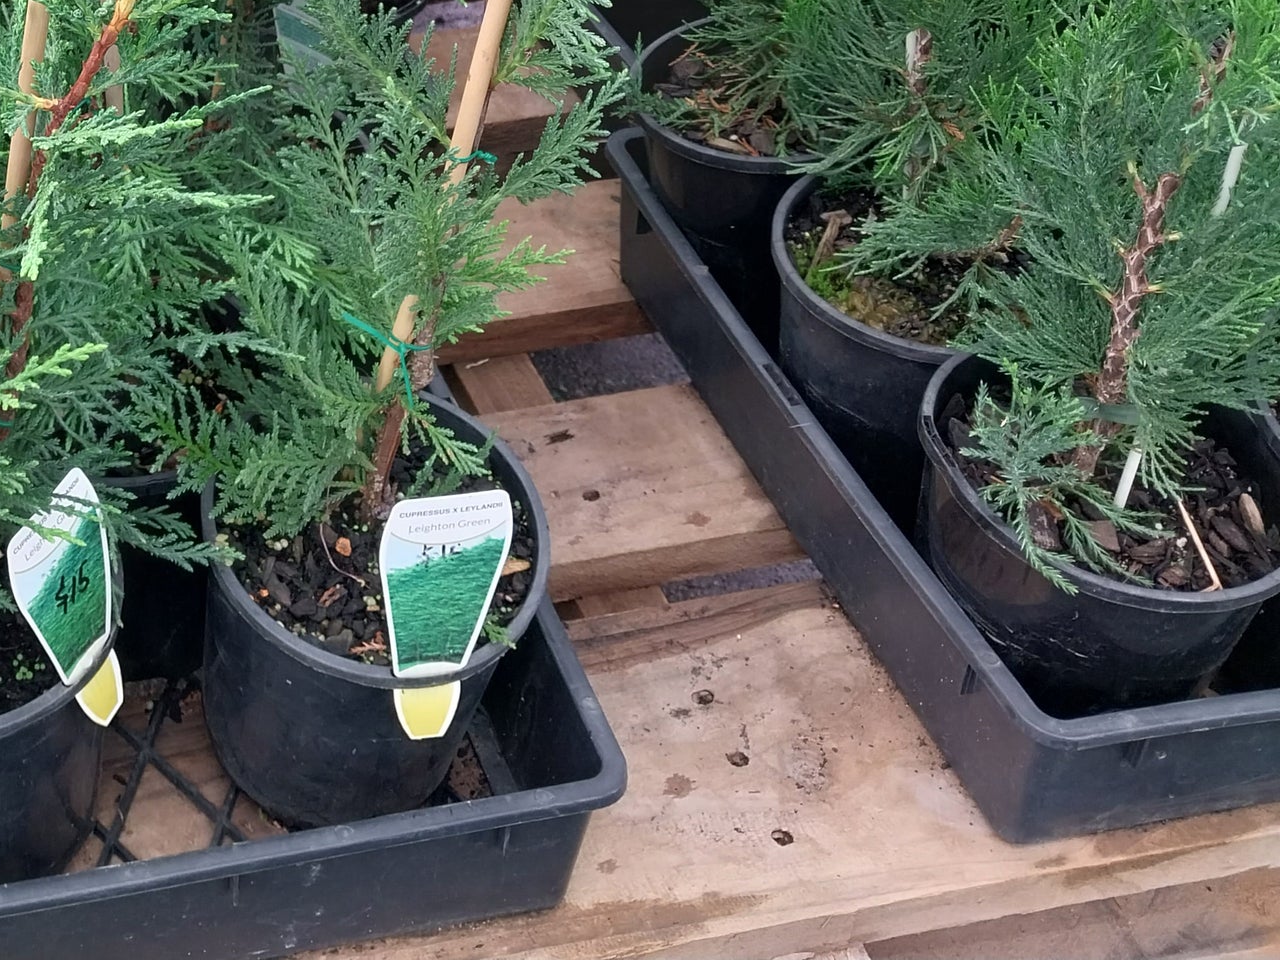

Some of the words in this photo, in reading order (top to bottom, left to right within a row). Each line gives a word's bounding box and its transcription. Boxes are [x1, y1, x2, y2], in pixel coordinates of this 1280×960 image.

[399, 508, 450, 519] CUPRESSUS
[408, 522, 456, 535] Leighton
[457, 517, 492, 529] Green
